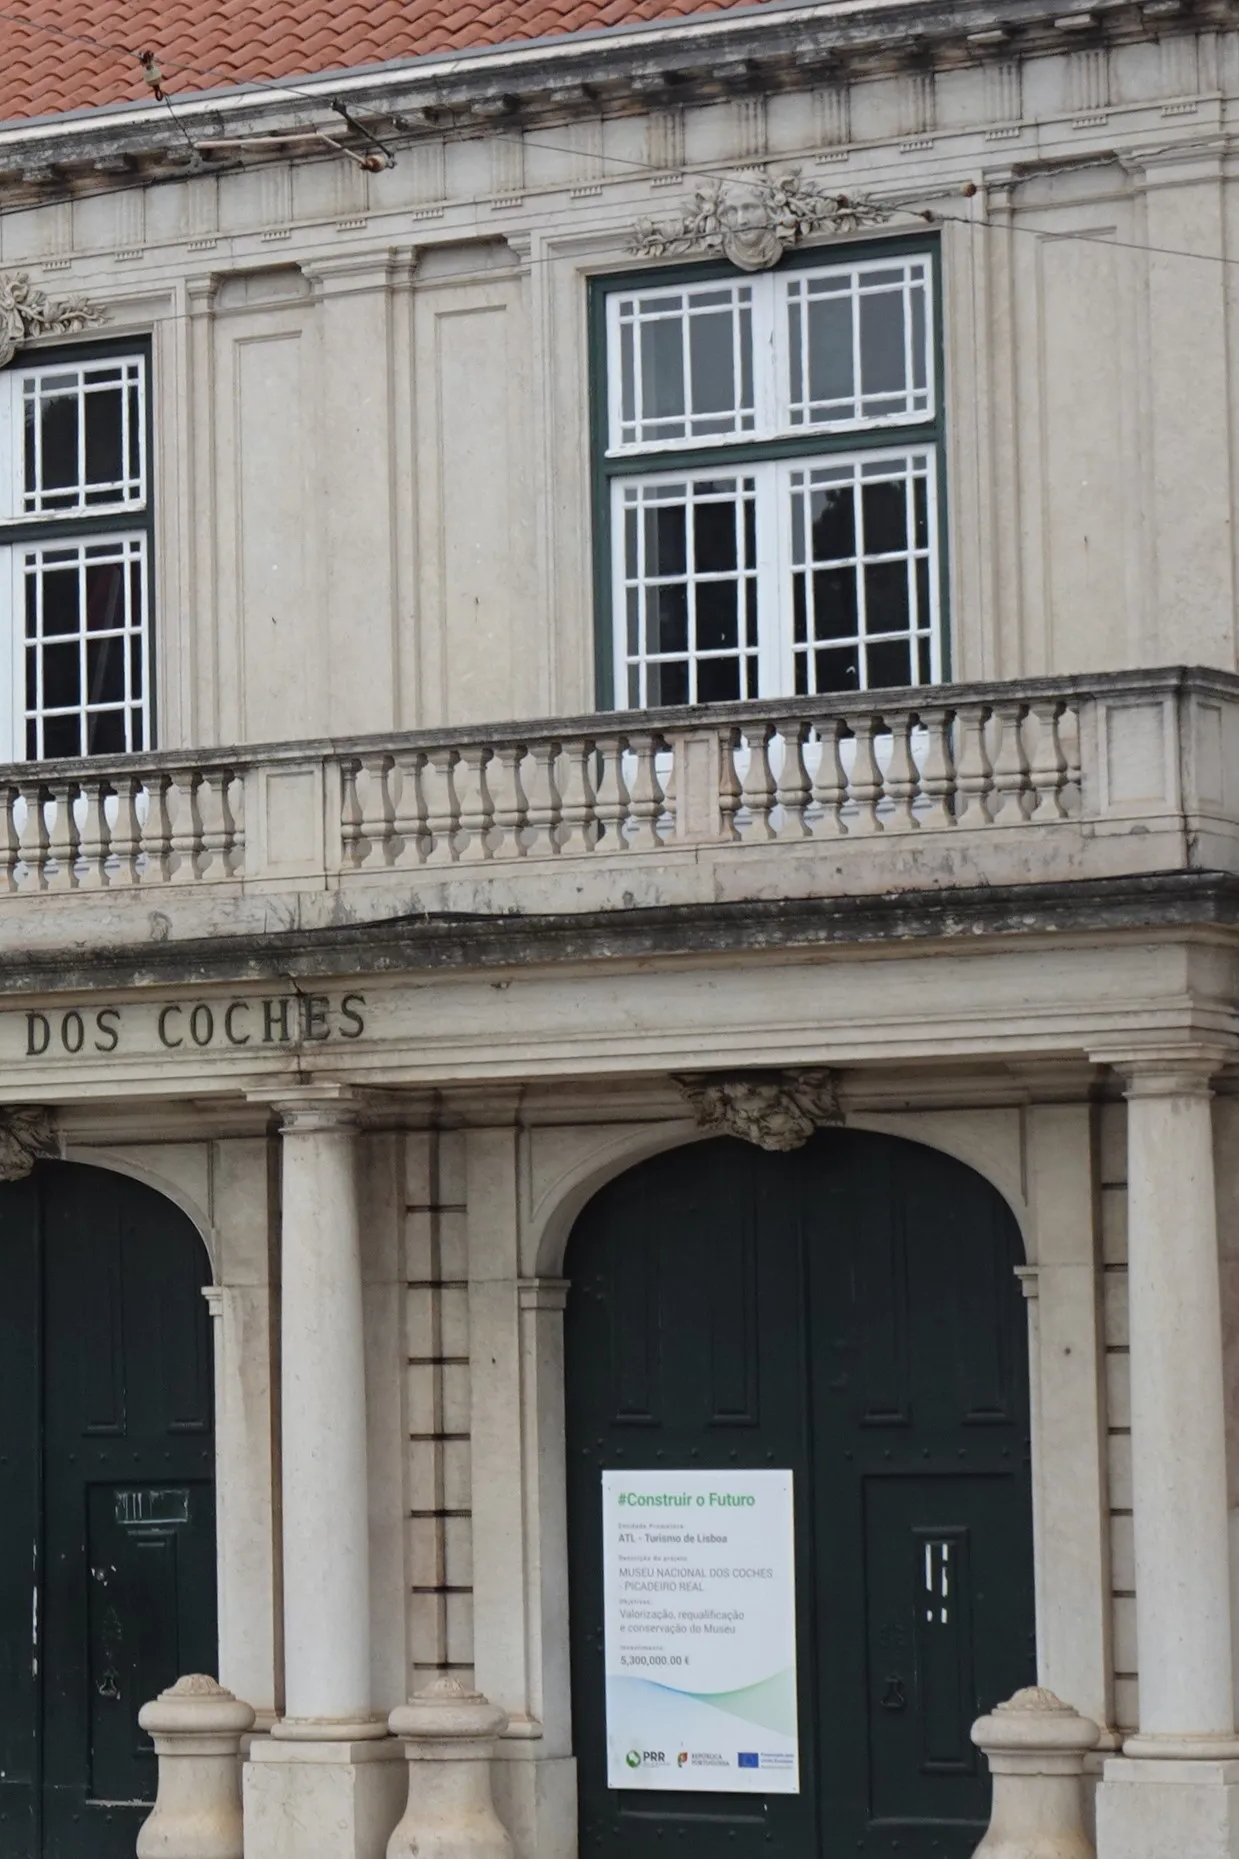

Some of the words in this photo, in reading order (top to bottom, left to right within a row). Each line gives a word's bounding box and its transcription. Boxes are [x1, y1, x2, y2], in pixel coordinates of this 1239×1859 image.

[25, 1008, 121, 1056] DOS
[159, 994, 367, 1049] COCHES
[618, 1492, 692, 1507] #Construir
[696, 1495, 705, 1507] o
[709, 1492, 756, 1507] Futuro
[618, 1533, 636, 1543] ATL
[645, 1533, 681, 1543] Turismo
[683, 1533, 695, 1543] de
[697, 1533, 728, 1543] Lisboa
[619, 1568, 655, 1578] MUSEU
[657, 1567, 706, 1578] NACIONAL
[709, 1567, 730, 1578] DOS
[732, 1567, 773, 1579] COCHES
[624, 1580, 677, 1592] PICADEIRO
[679, 1580, 705, 1592] REAL
[620, 1609, 676, 1620] Valorização,
[678, 1609, 745, 1622] requalificação
[620, 1625, 626, 1633] e
[628, 1623, 687, 1635] conservação
[689, 1623, 702, 1633] do
[703, 1623, 736, 1634] Museu
[643, 1751, 665, 1761] PRR
